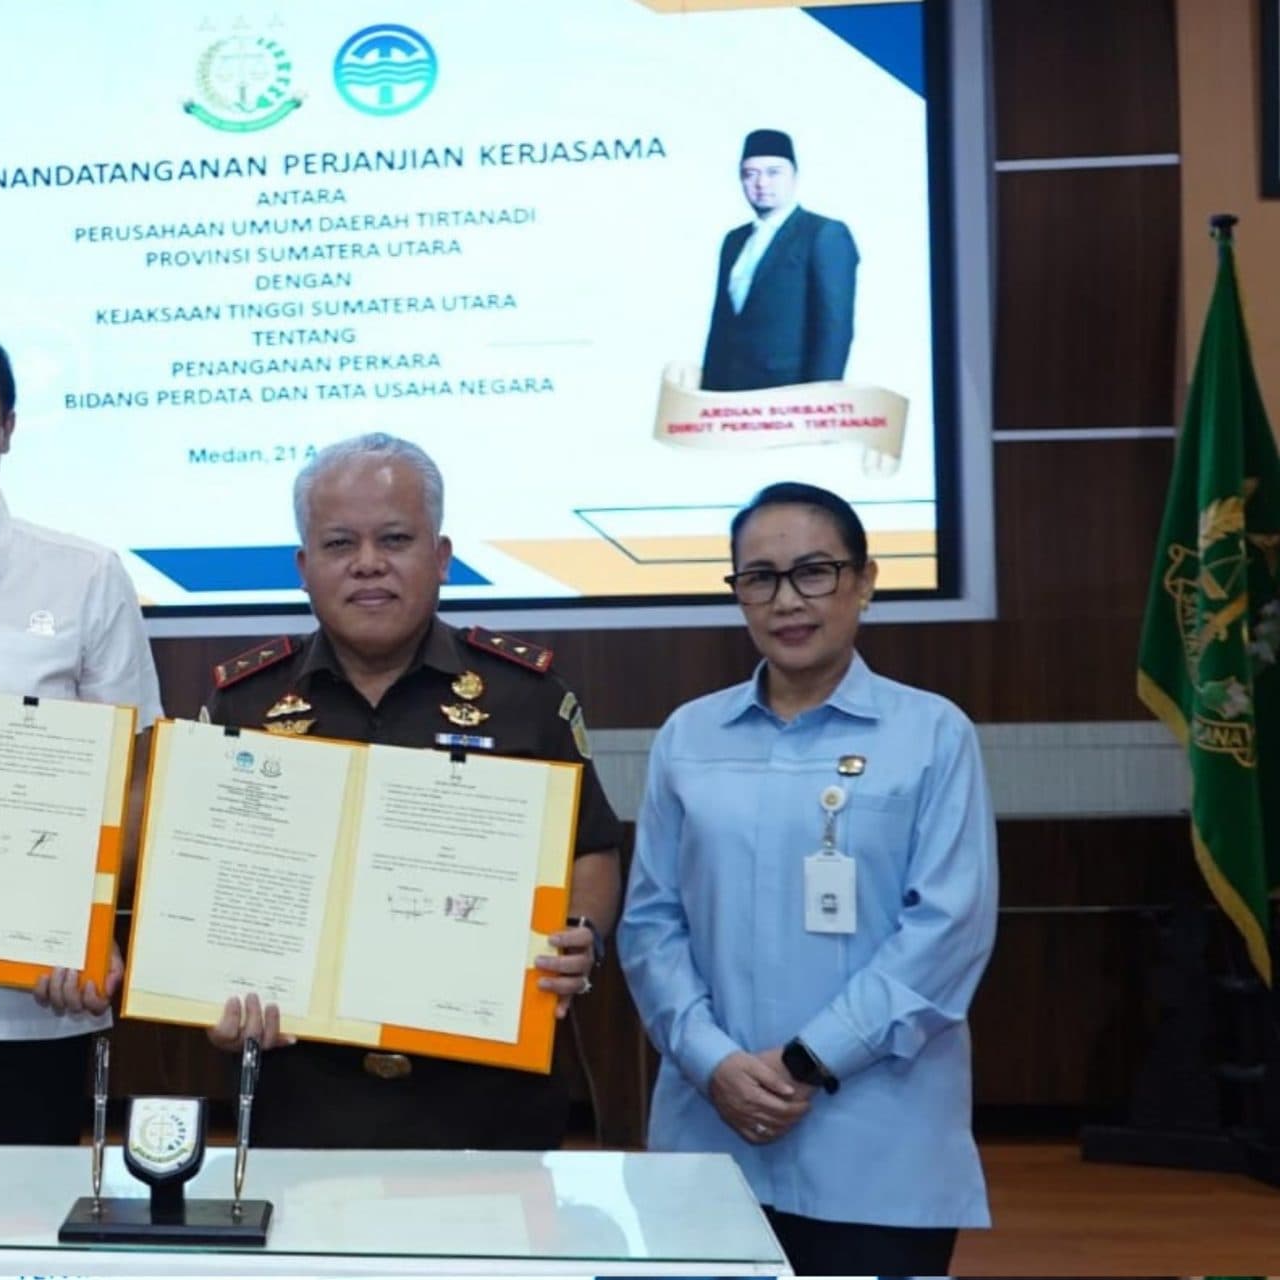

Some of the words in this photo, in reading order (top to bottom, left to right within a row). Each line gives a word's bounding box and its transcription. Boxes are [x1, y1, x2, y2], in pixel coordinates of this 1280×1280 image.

[283, 146, 464, 177] PERJANJIAN
[479, 136, 667, 167] KERJASAMA
[255, 187, 347, 207] ANTARA
[74, 220, 225, 243] PERUSAHAAN
[231, 217, 313, 237] UMUM
[319, 212, 410, 234] DAERAH
[417, 207, 537, 228] TIRTANADI
[145, 248, 251, 268] PROVINSI
[257, 242, 381, 263] SUMATERA
[387, 238, 462, 258] UTARA
[255, 272, 352, 292] DENGAN
[96, 304, 221, 325] KEJAKSAAN
[228, 300, 304, 319] TINGGI
[311, 296, 436, 317] SUMATERA
[441, 293, 517, 312] UTARA
[252, 328, 356, 347] TENTANG
[171, 356, 332, 378] PENANGANAN
[338, 352, 441, 371] PERKARA
[65, 390, 150, 410] BIDANG
[156, 386, 253, 406] PERDATA
[260, 385, 308, 403] DAN
[315, 382, 367, 400] TATA
[373, 380, 453, 399] USAHA
[459, 376, 555, 396] NEGARA
[699, 407, 762, 419] ARDIAN
[770, 403, 854, 416] SURBAKTI
[668, 423, 713, 434] DIRUT
[188, 447, 269, 465] Medan,
[274, 445, 297, 462] 21
